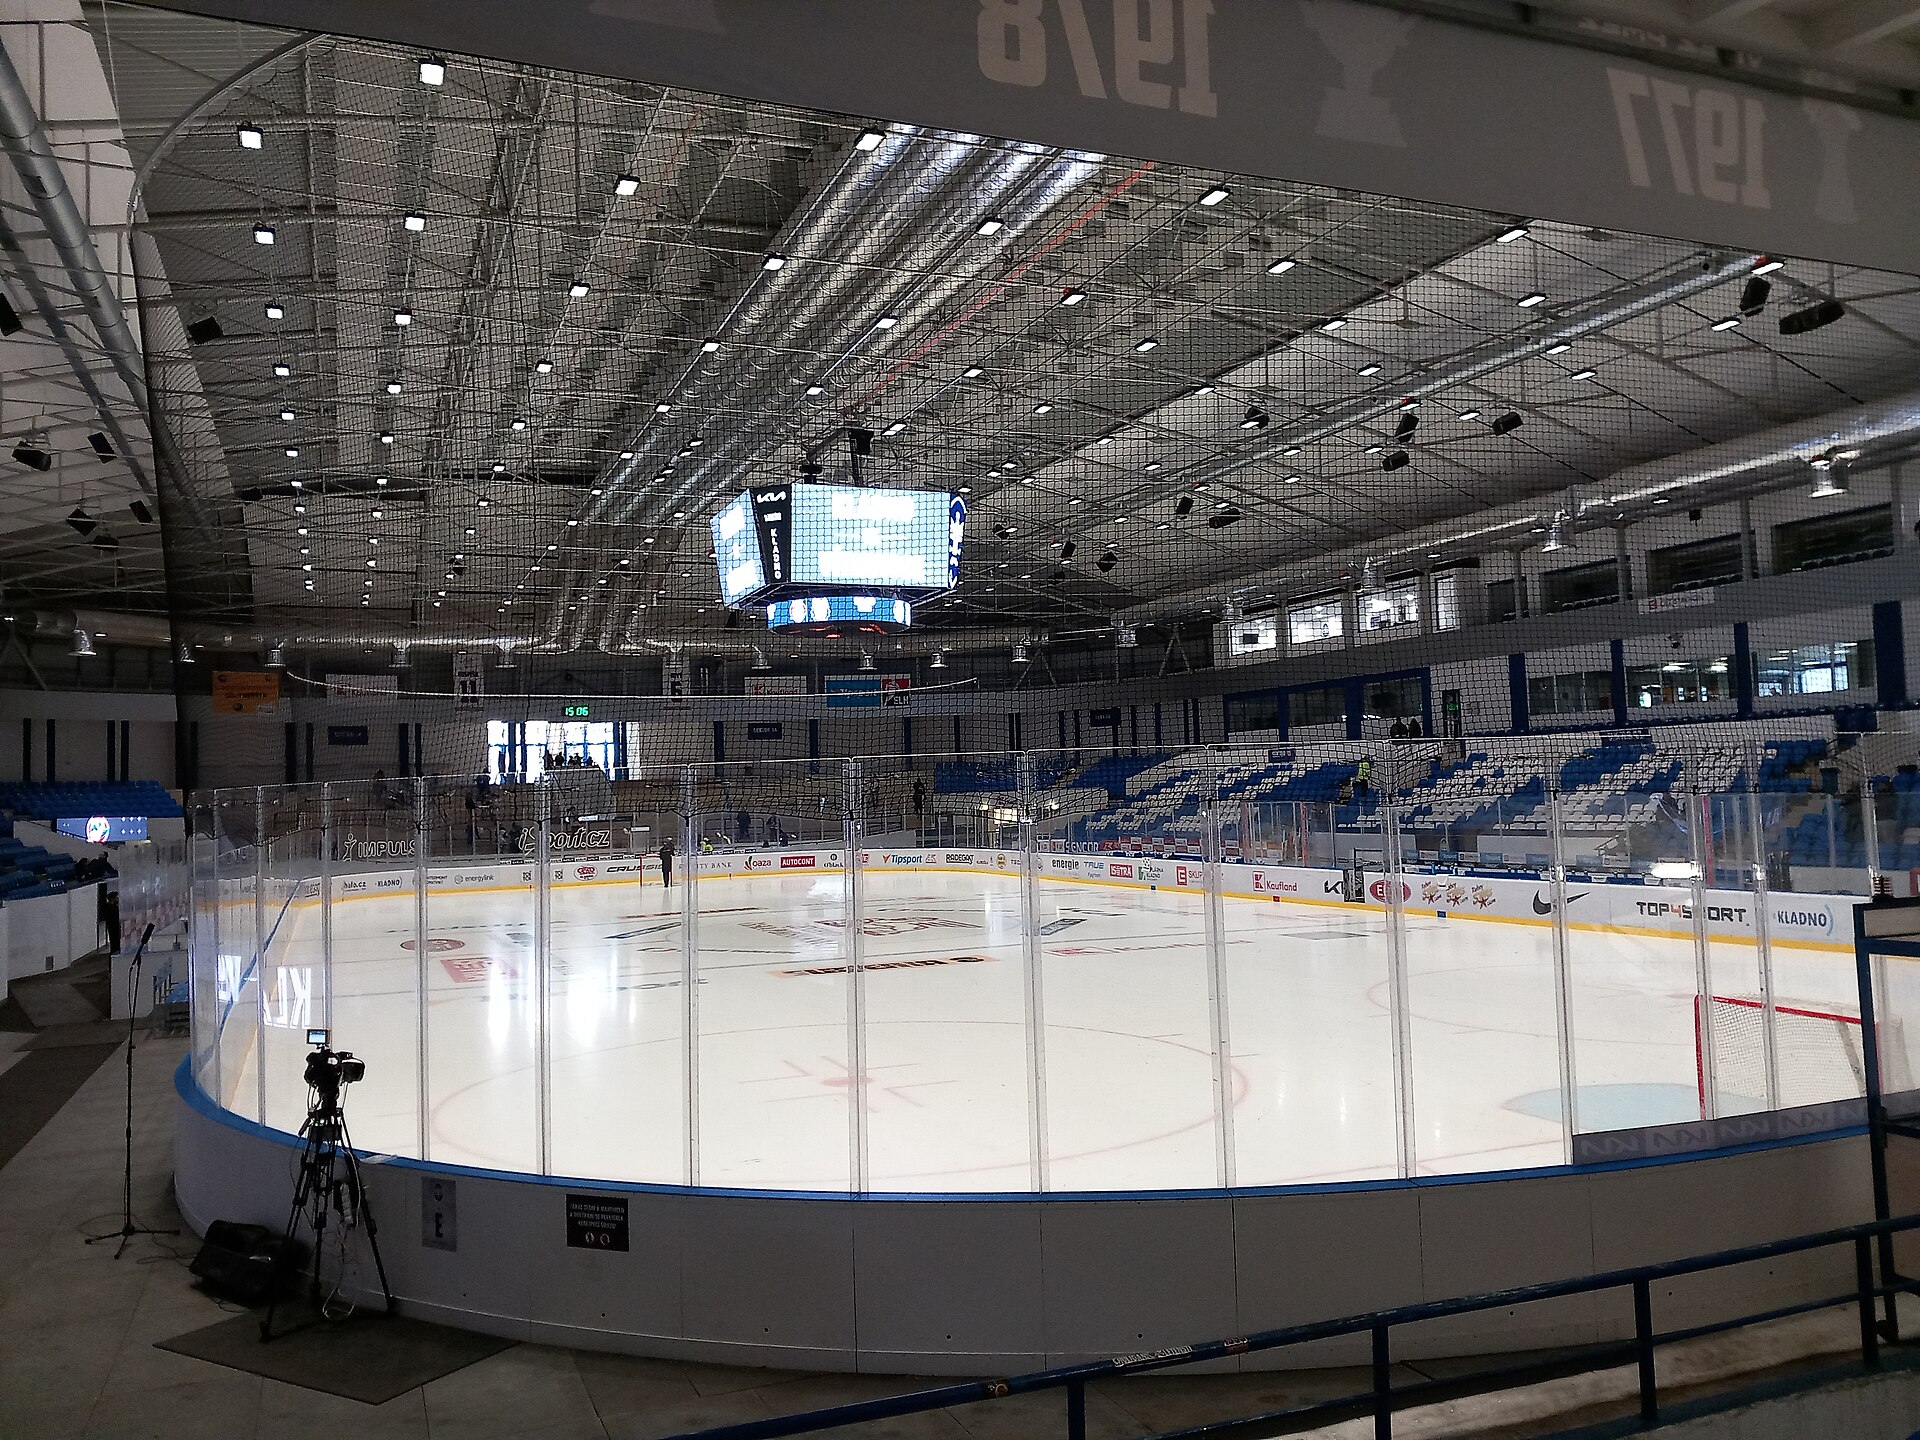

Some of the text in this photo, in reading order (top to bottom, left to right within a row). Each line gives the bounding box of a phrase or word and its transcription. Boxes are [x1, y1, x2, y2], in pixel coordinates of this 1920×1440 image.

[769, 528, 782, 580] KLADNO
[711, 861, 732, 869] BANK
[782, 858, 814, 867] AUTOCONT
[891, 855, 922, 865] Tipsport
[1052, 859, 1080, 871] energie
[465, 874, 494, 882] energylink
[377, 879, 400, 888] KLADNO
[1266, 880, 1297, 892] Kaufland
[1777, 910, 1827, 928] KLADNO
